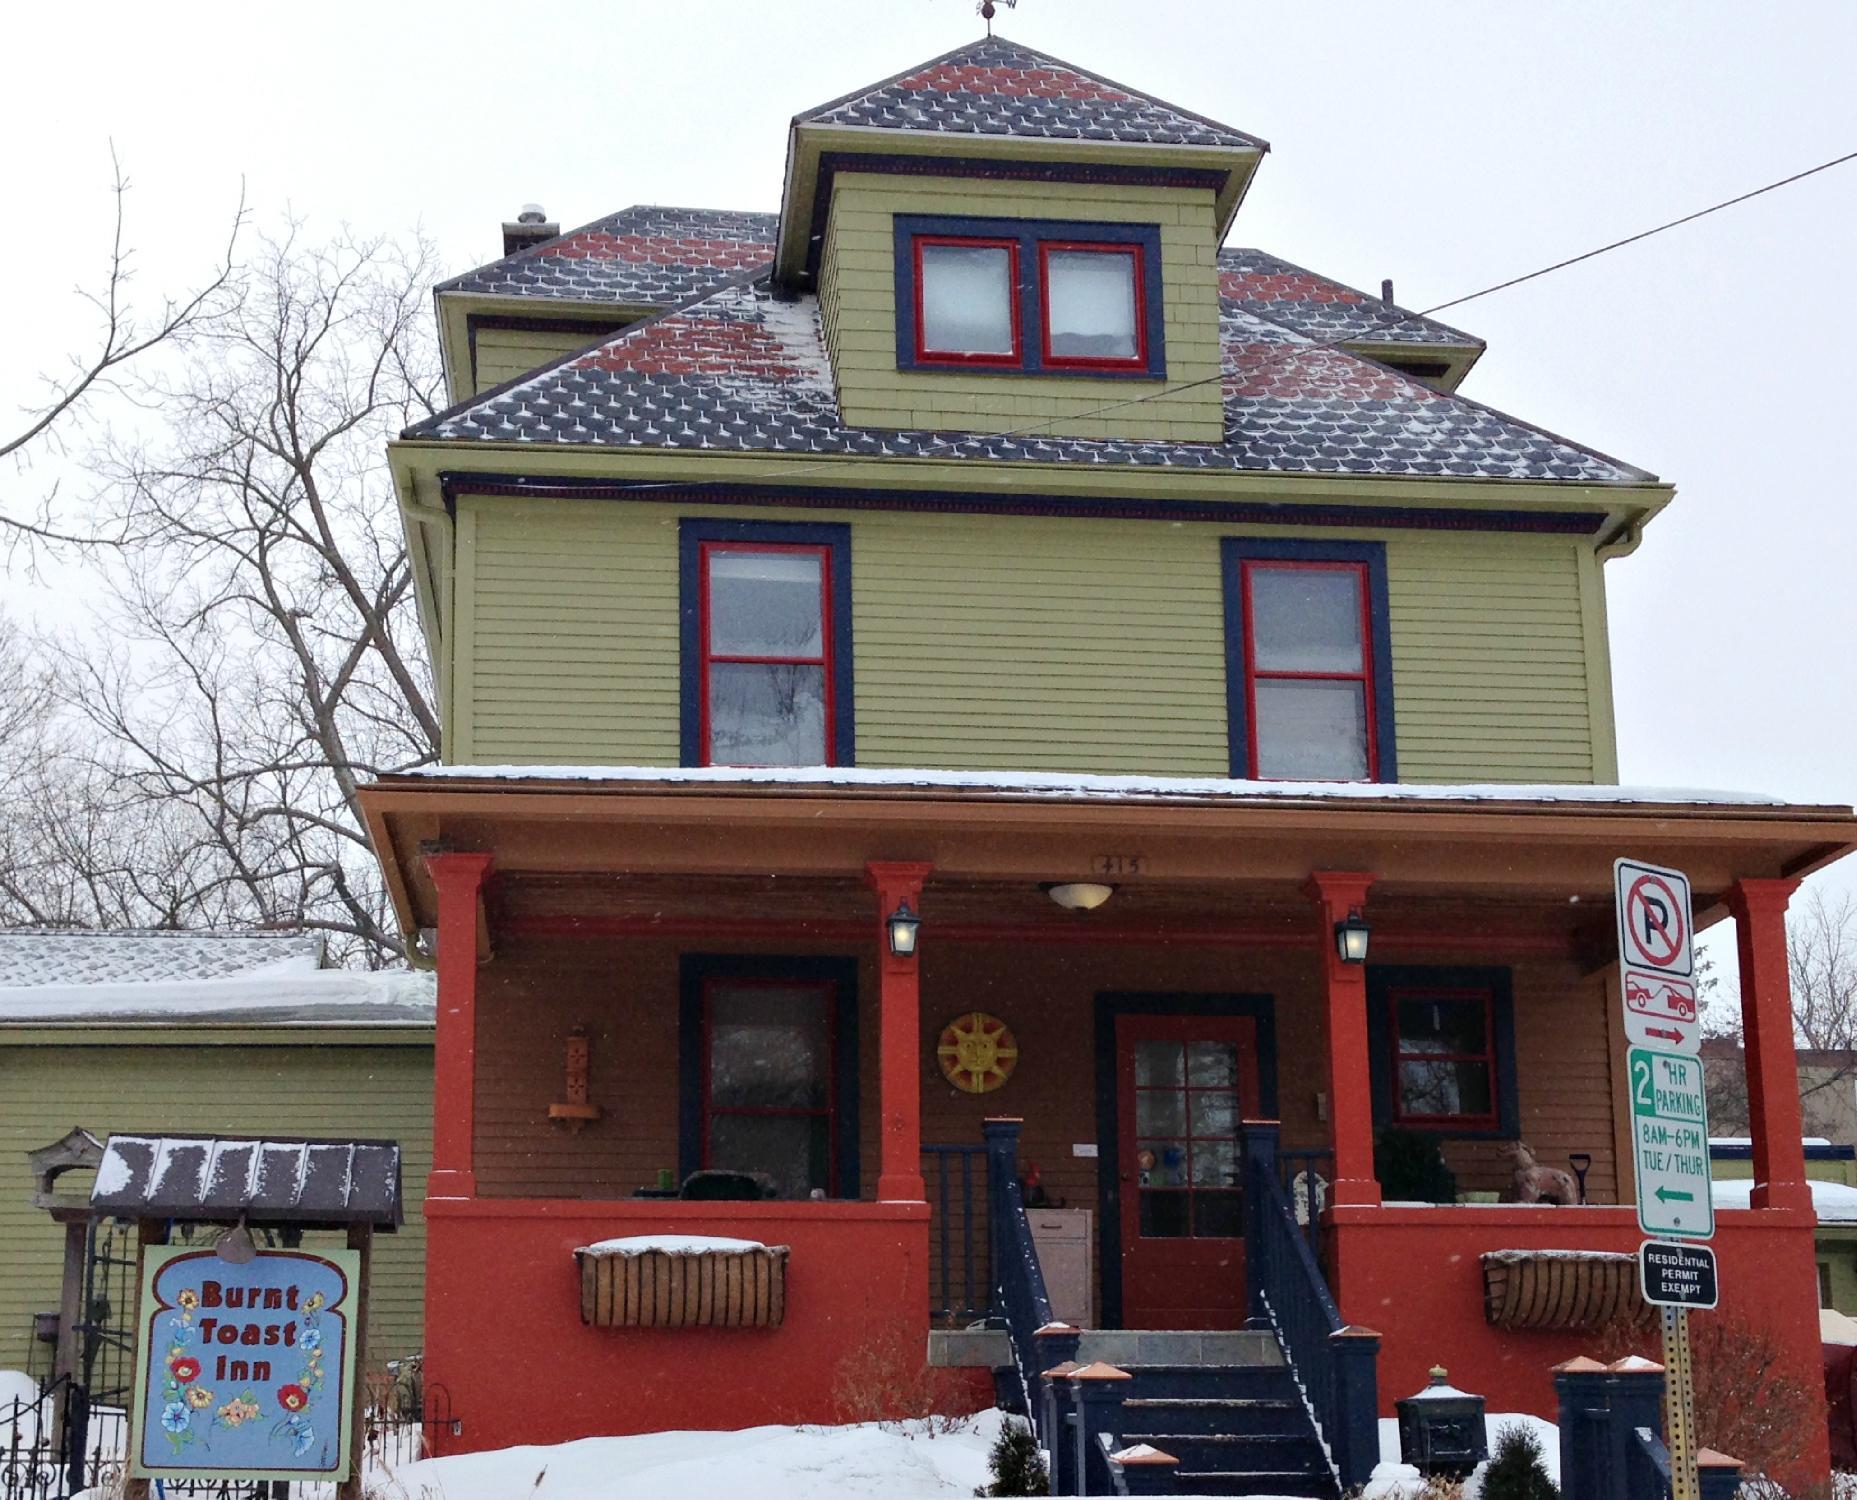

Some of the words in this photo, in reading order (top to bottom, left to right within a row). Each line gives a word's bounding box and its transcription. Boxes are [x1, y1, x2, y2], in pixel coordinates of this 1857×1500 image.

[1634, 1060, 1652, 1105] 2
[1668, 1064, 1687, 1086] HR
[1655, 1088, 1700, 1117] PARKING
[1648, 1253, 1710, 1269] RESIDENTIAL
[1661, 1268, 1699, 1281] PERMIT
[201, 1280, 299, 1311] Burnt
[1661, 1282, 1701, 1295] EXEMPT
[199, 1318, 297, 1347] Toast
[216, 1355, 271, 1382] Inn
